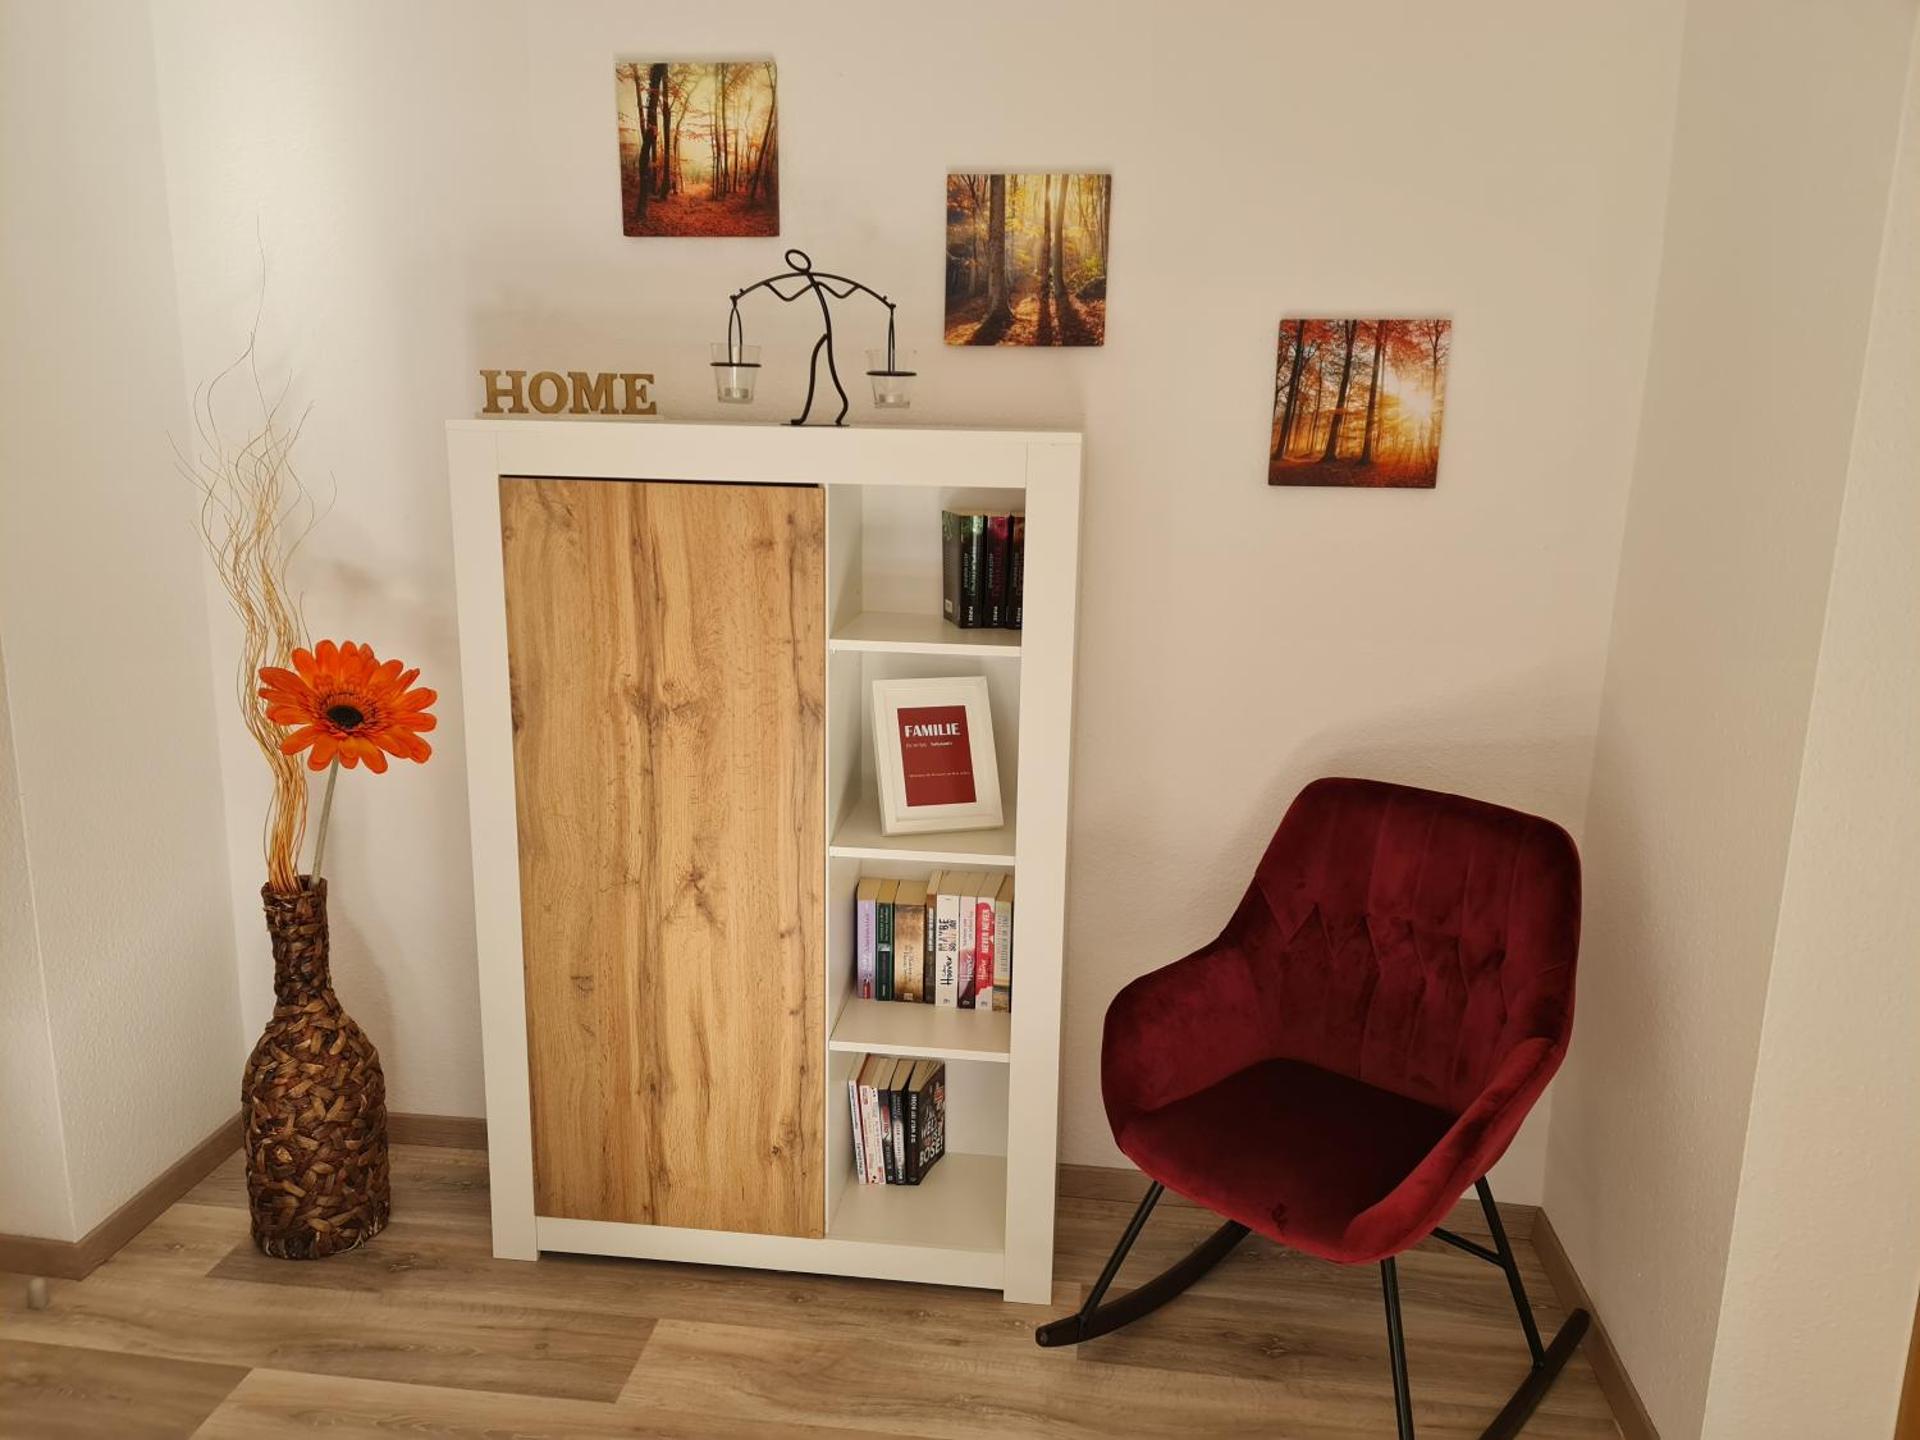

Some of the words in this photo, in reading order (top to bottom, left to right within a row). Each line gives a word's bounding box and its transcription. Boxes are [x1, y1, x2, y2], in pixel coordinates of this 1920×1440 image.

[480, 370, 657, 415] HOME
[904, 723, 961, 738] FAMILIE
[940, 955, 954, 985] Hoover
